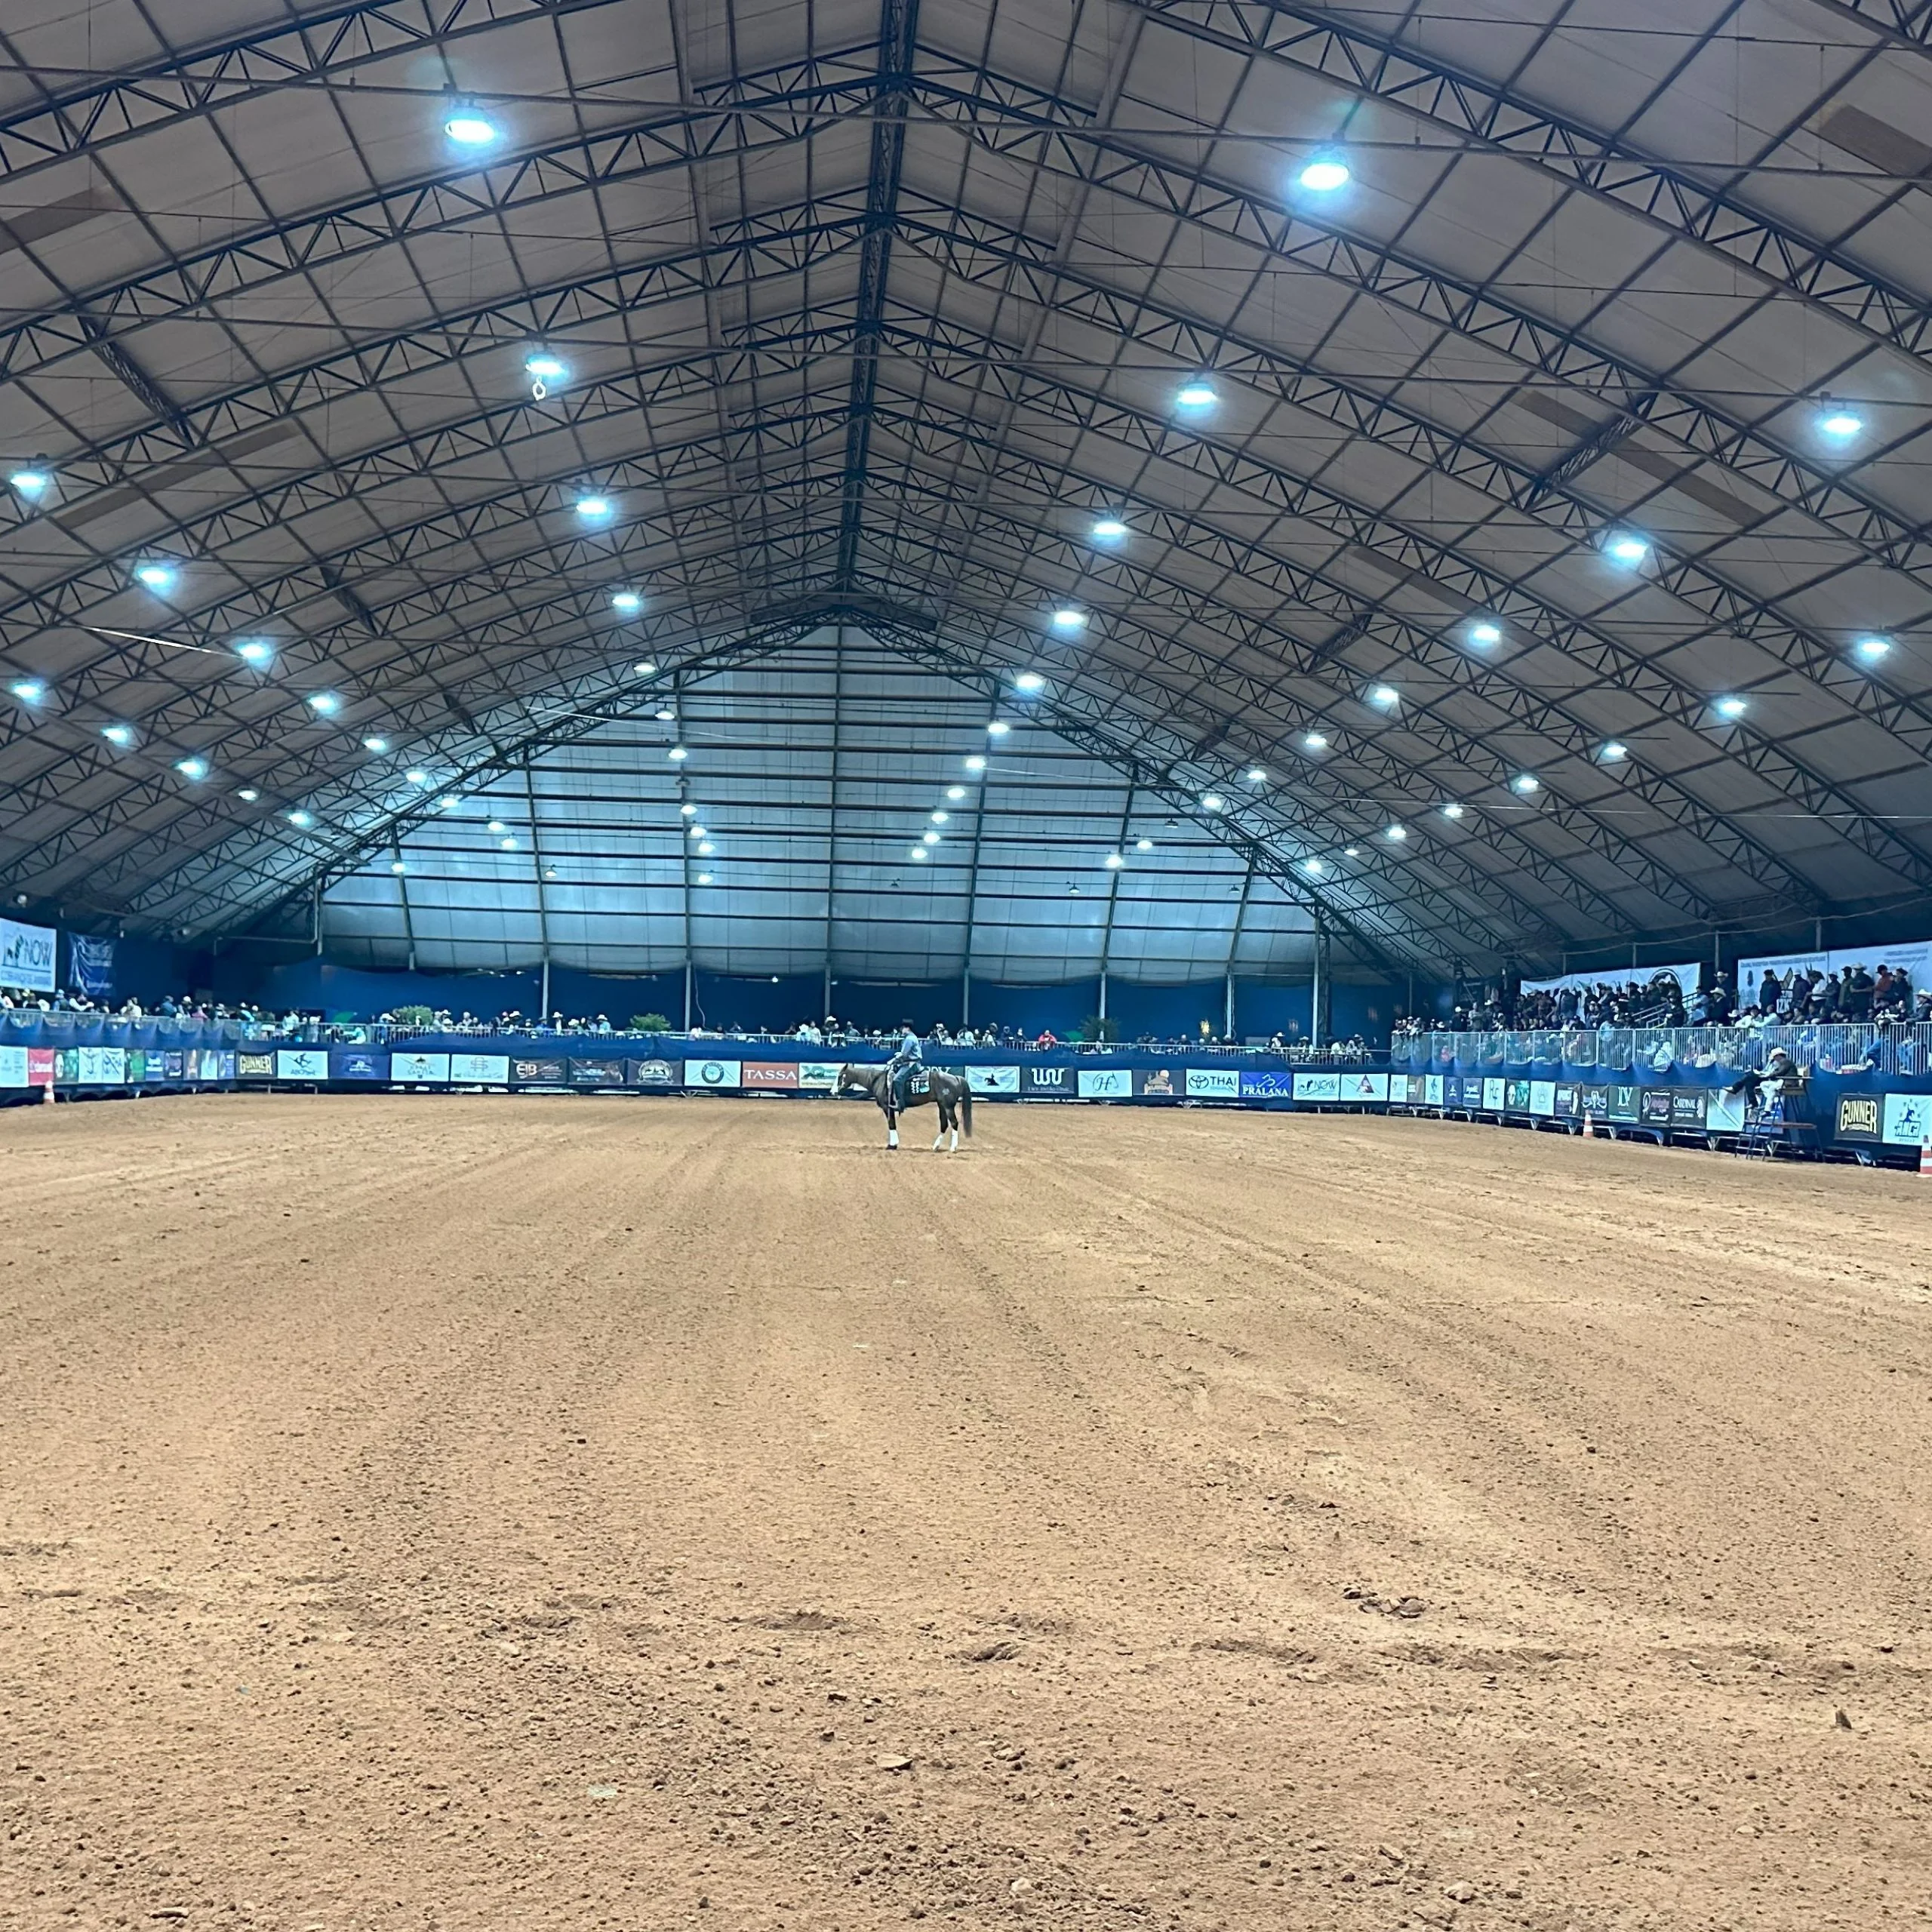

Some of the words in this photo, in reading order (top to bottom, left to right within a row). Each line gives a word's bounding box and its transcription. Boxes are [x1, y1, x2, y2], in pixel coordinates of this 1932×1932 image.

[24, 938, 52, 967] NOW
[240, 1055, 272, 1075] GUNNER
[743, 1069, 797, 1080] TASSA
[1210, 1075, 1237, 1086] THAI
[1242, 1084, 1288, 1097] PRALANA
[1314, 1080, 1338, 1091] NOW
[1840, 1100, 1877, 1134] GUNNER
